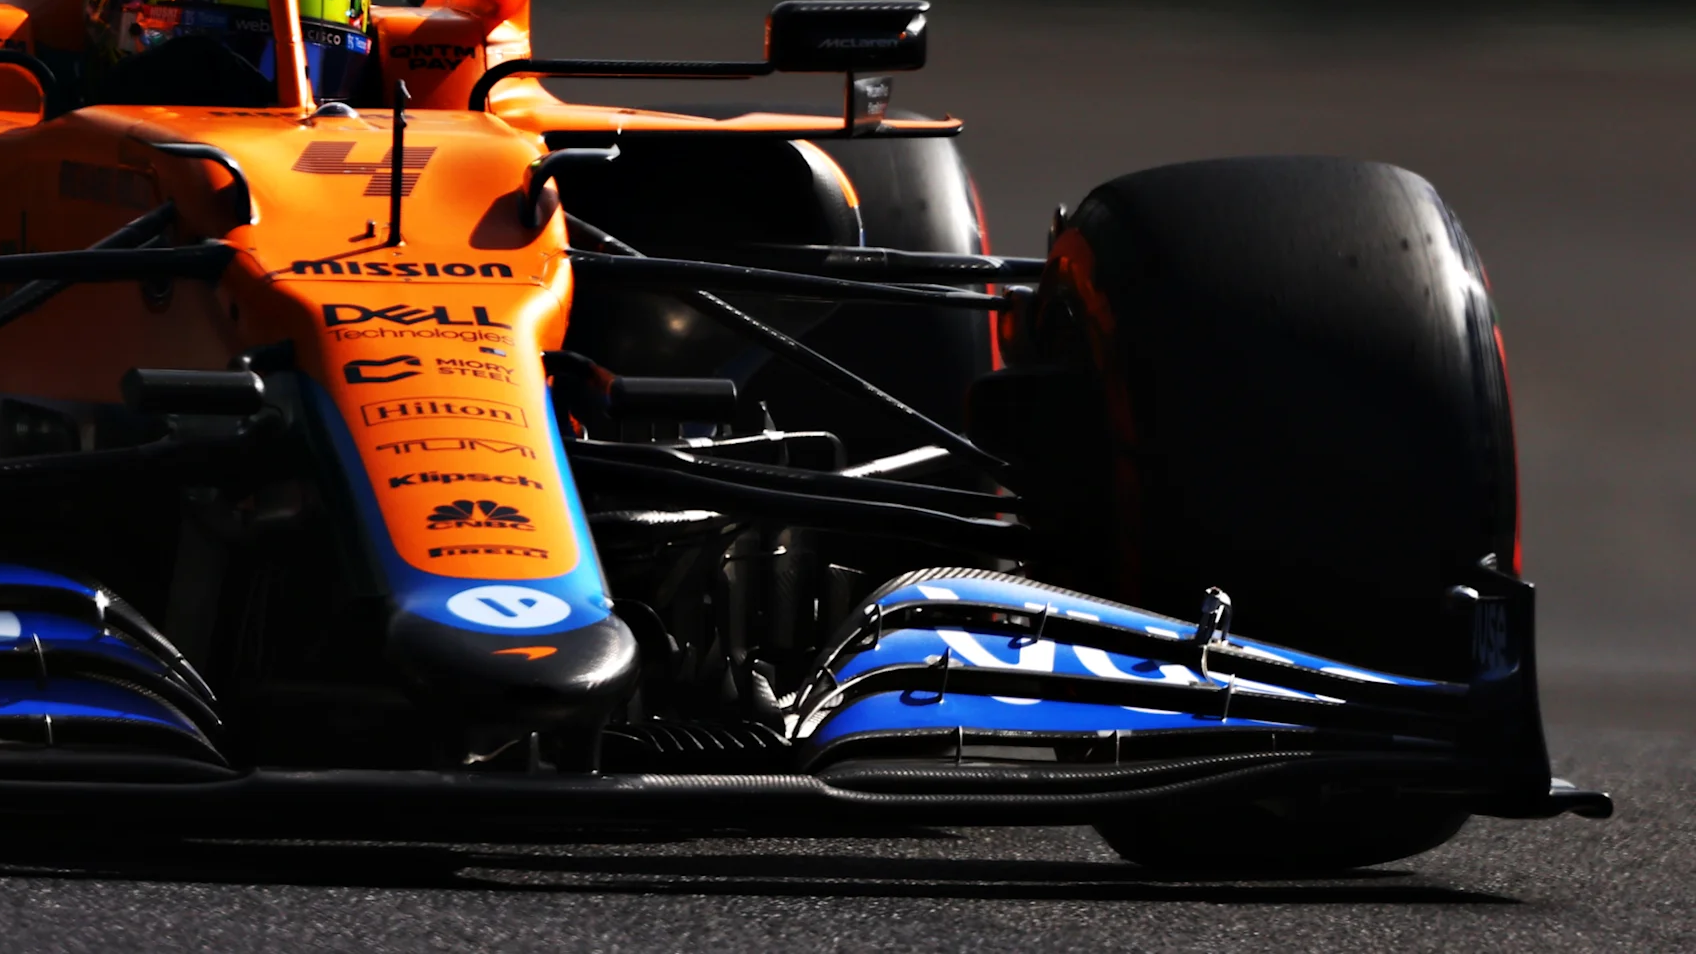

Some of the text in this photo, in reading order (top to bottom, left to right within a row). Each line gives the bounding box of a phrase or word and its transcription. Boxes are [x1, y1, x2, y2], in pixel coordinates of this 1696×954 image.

[235, 19, 271, 32] web
[816, 37, 900, 49] McLaren
[408, 58, 463, 70] PAY
[291, 140, 438, 197] 4
[290, 259, 514, 279] mission
[321, 303, 513, 331] DELL
[327, 326, 516, 347] Technologies
[437, 366, 521, 387] STEEL
[377, 401, 513, 421] Hilton
[375, 437, 537, 460] TUMI
[388, 470, 544, 490] Klipsch
[426, 520, 537, 532] CNBC
[428, 544, 550, 559] PIRELLI
